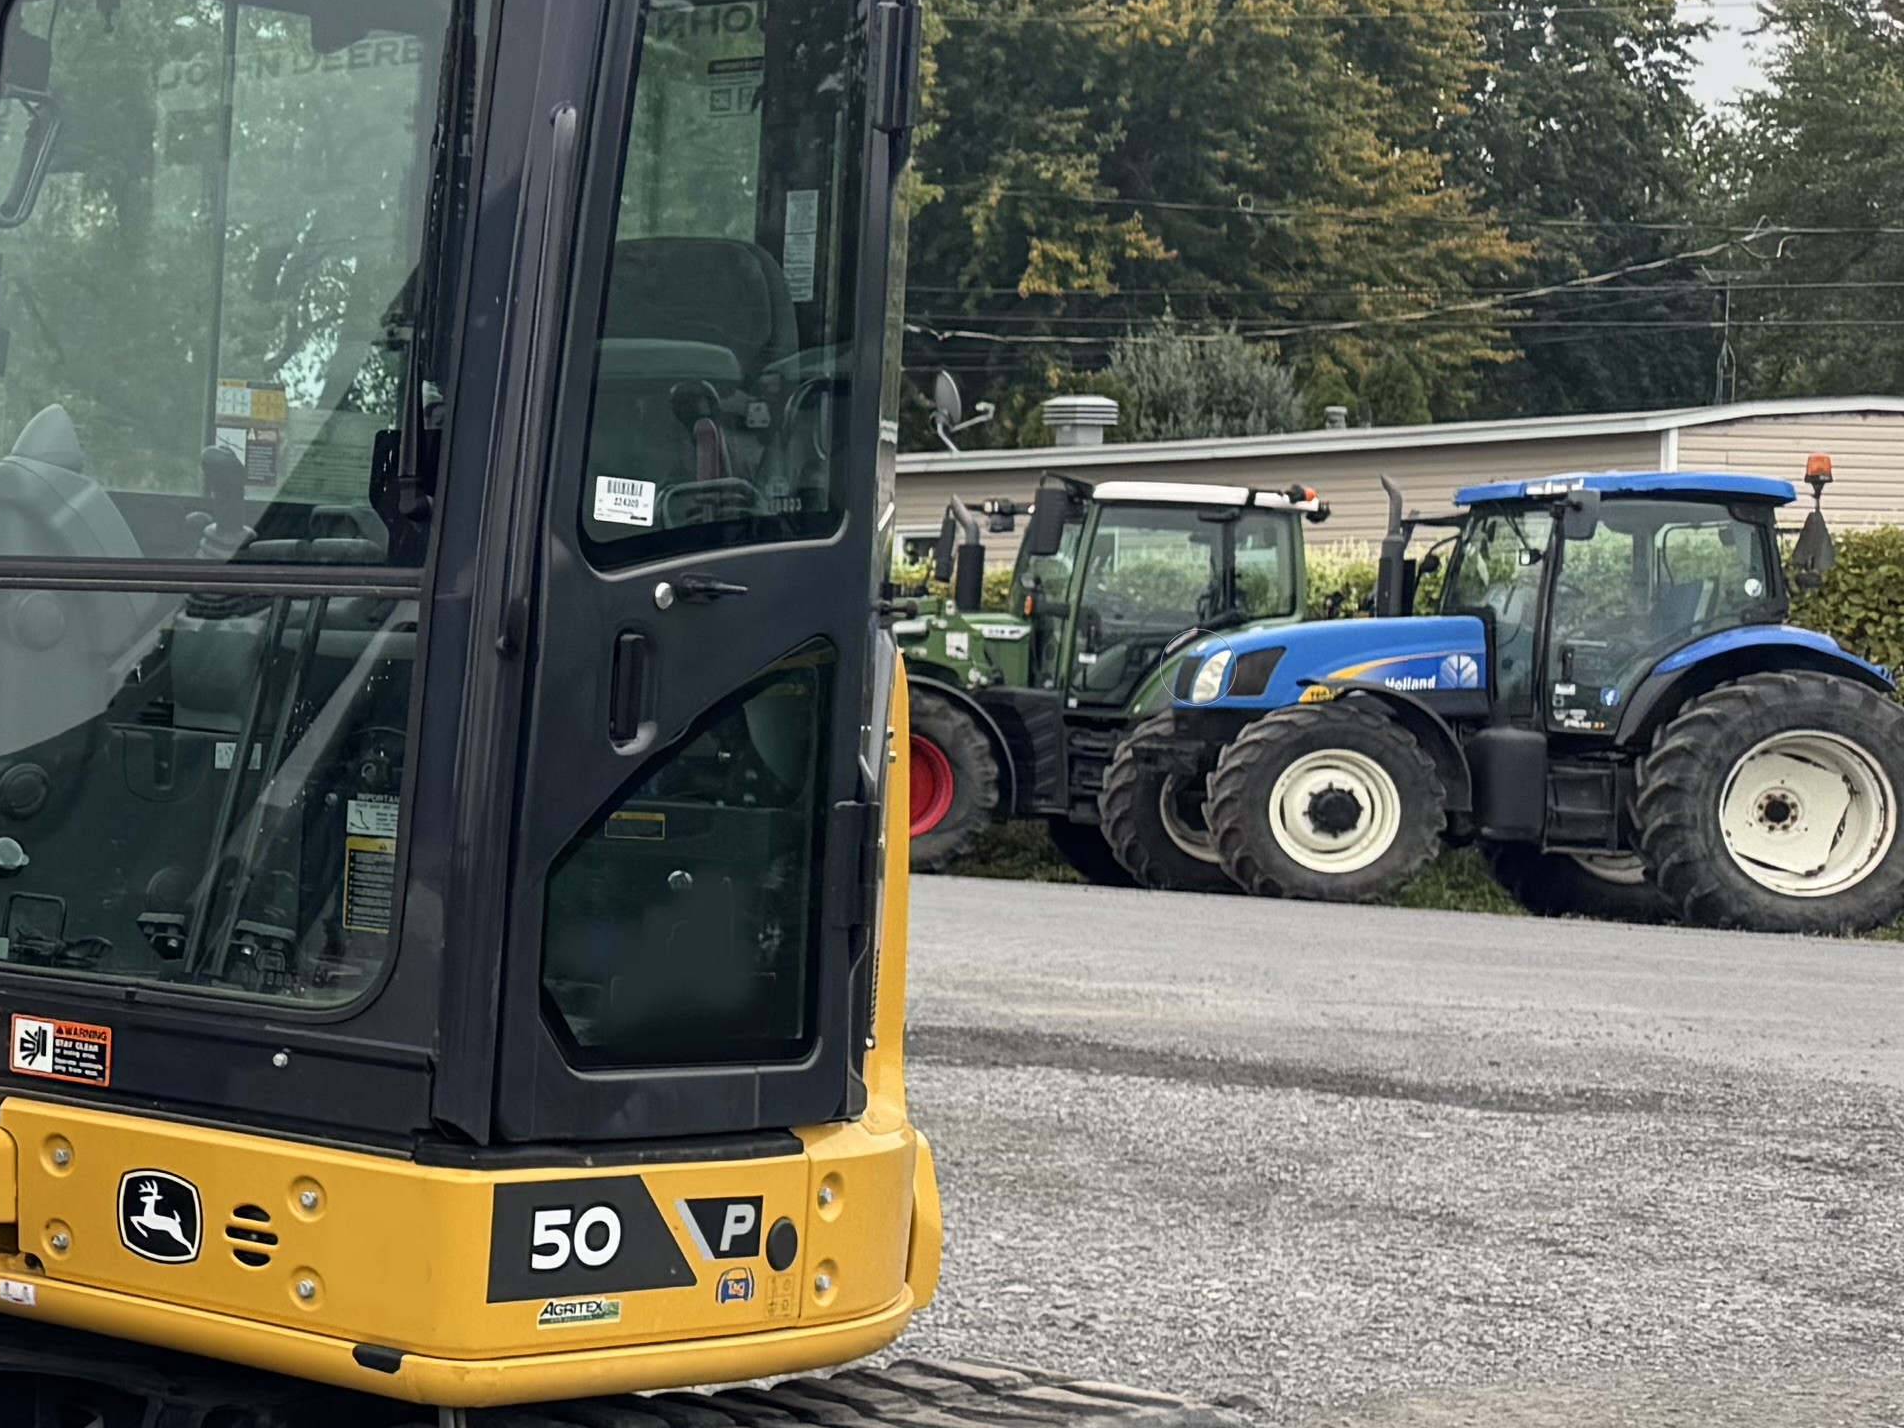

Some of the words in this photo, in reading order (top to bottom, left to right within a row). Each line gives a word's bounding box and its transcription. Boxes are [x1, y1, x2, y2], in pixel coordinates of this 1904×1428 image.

[1384, 675, 1436, 692] Holland
[65, 1027, 107, 1041] WARNING
[720, 1204, 755, 1252] P
[531, 1206, 621, 1270] 50
[540, 1301, 602, 1317] AGRITEX
